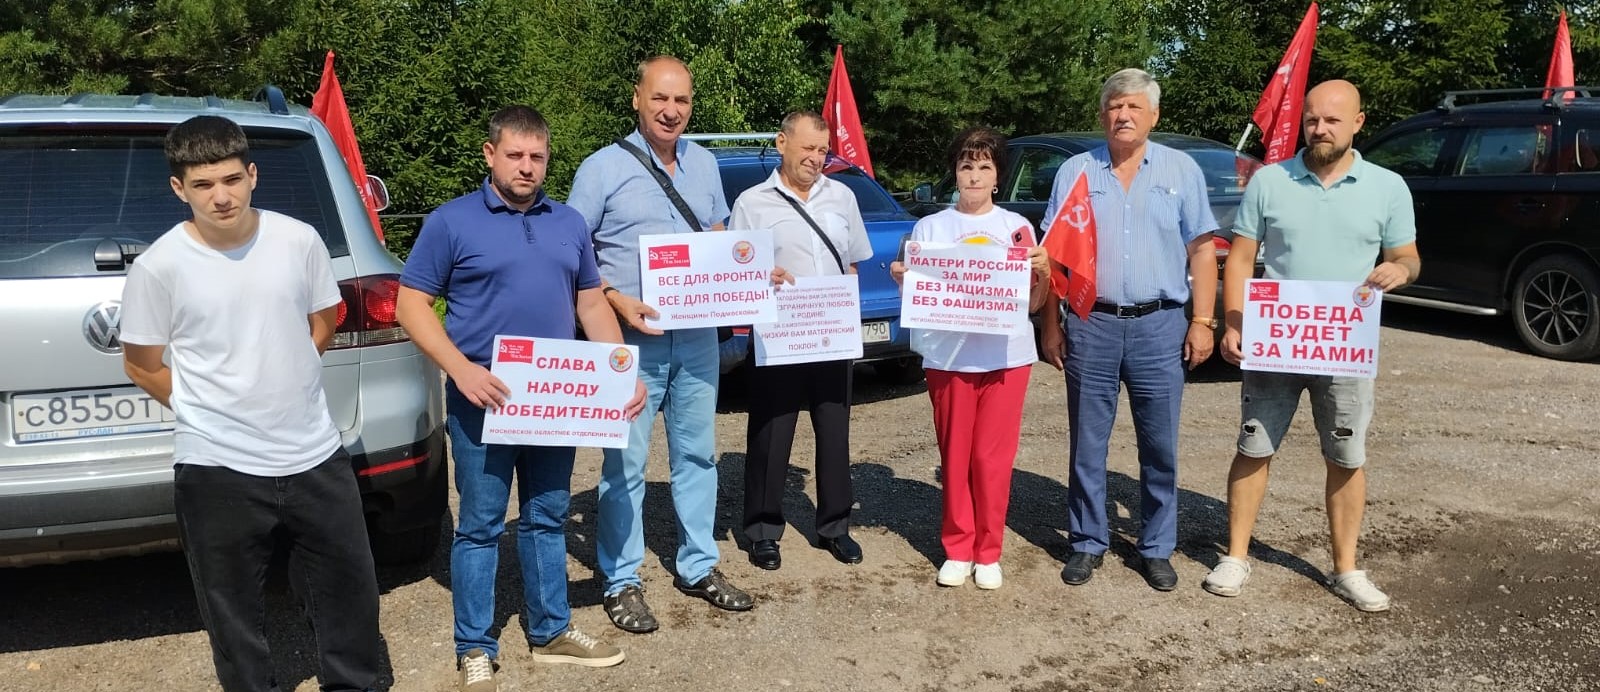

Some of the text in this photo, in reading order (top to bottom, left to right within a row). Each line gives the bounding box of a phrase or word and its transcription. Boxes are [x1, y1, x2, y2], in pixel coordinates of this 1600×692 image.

[910, 256, 965, 268] МАТЕРИ
[658, 269, 767, 287] ВСЕ ДЛЯ ФРОНТА!
[941, 270, 991, 282] ЗА МИР
[658, 295, 680, 306] ВСЕ
[683, 293, 710, 306] ДЛЯ
[713, 289, 769, 303] ПОБЕДЫ!
[916, 281, 1018, 298] БЕЗ НАЦИЗМА!
[826, 300, 855, 308] ЛЮБОВЬ
[912, 295, 1018, 312] БЕЗ ФАШИЗМА!
[671, 312, 709, 320] Женщины
[1259, 303, 1364, 325] ПОБЕДА
[761, 326, 855, 339] НИЗКИЙ ВАМ МАТЕРИНСКИЙ
[1270, 323, 1353, 343] БУДЕТ
[1251, 342, 1374, 364] ЗА НАМИ!
[536, 356, 596, 372] СЛАВА
[527, 381, 600, 398] НАРОДУ
[492, 404, 627, 421] ПОБЕДИТЕЛЮ!
